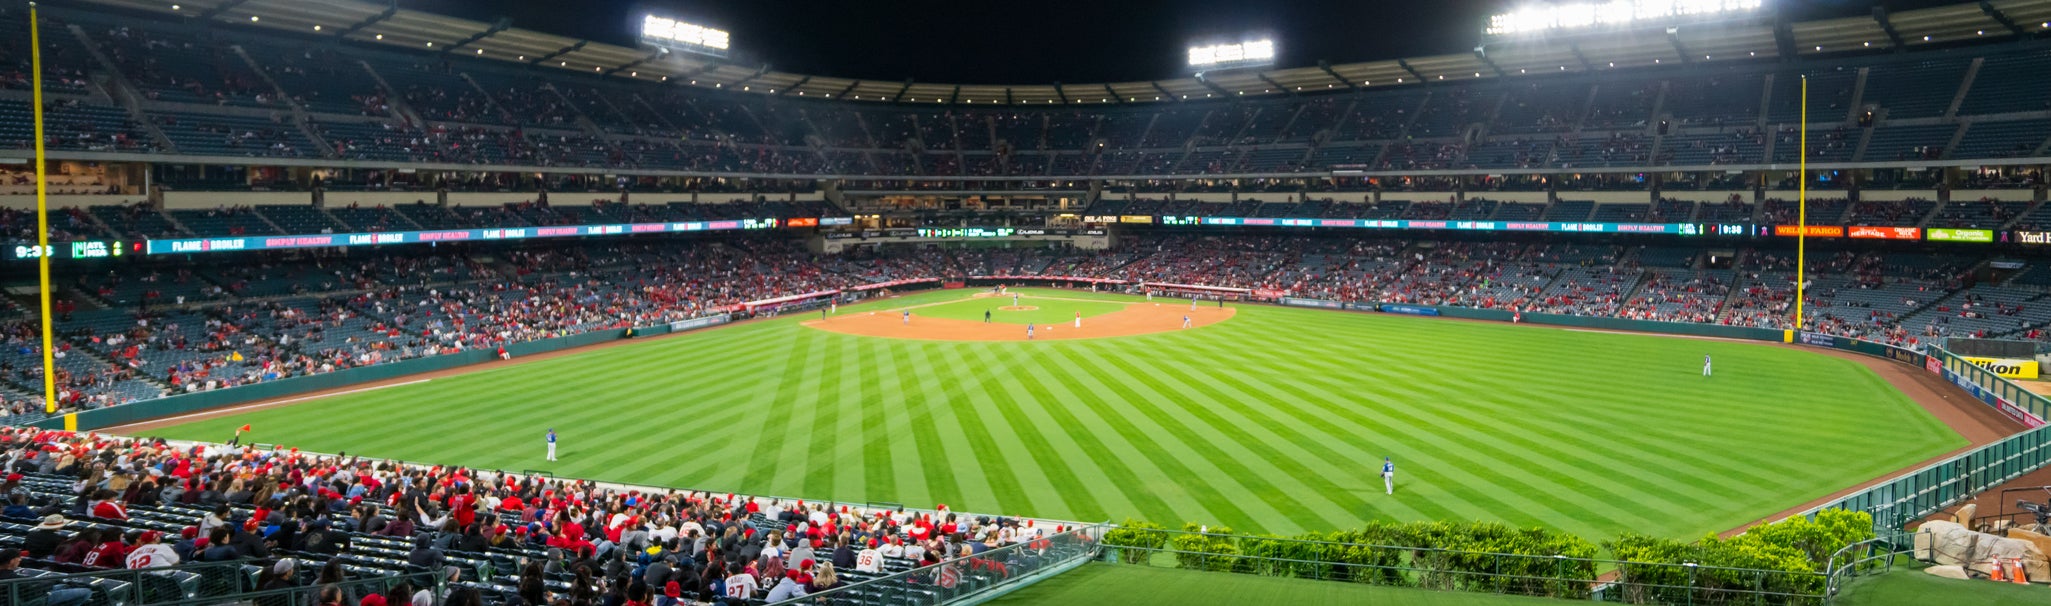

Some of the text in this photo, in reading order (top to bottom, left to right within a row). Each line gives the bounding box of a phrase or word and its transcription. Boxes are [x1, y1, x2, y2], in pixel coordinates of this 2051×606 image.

[1810, 227, 1841, 235] FARGO
[2019, 231, 2044, 243] Yard
[172, 241, 201, 251] FLAME
